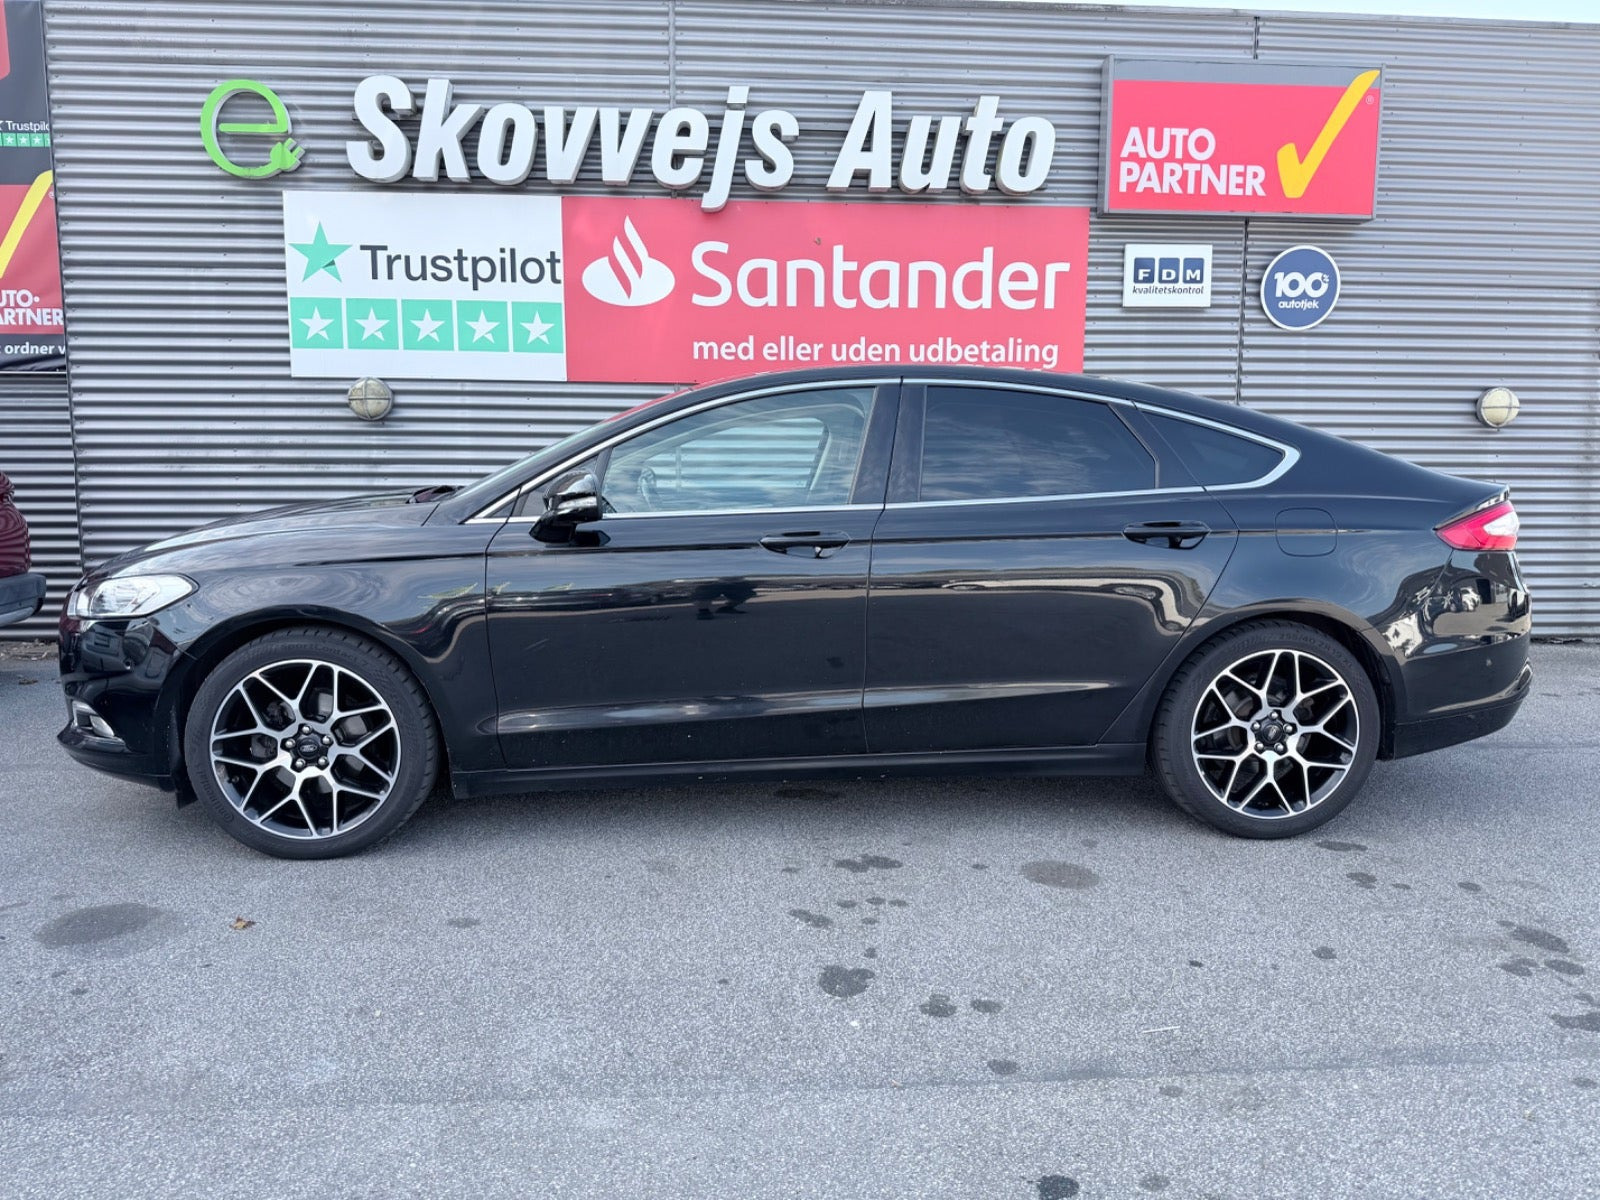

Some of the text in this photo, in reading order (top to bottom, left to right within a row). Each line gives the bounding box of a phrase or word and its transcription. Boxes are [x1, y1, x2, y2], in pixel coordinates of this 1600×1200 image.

[346, 74, 1056, 213] Skovvejs Auto
[1120, 126, 1216, 161] AUTO
[1119, 161, 1267, 197] PARTNER
[360, 244, 562, 292] Trustpilot
[691, 240, 1071, 311] Santander
[1136, 266, 1203, 282] FDM
[1132, 285, 1204, 295] kvalitetskontrol
[1278, 299, 1319, 311] autotjek
[0, 307, 64, 326] RTNER
[4, 341, 55, 354] ordner
[692, 335, 1059, 369] med eller uden udbetaling
